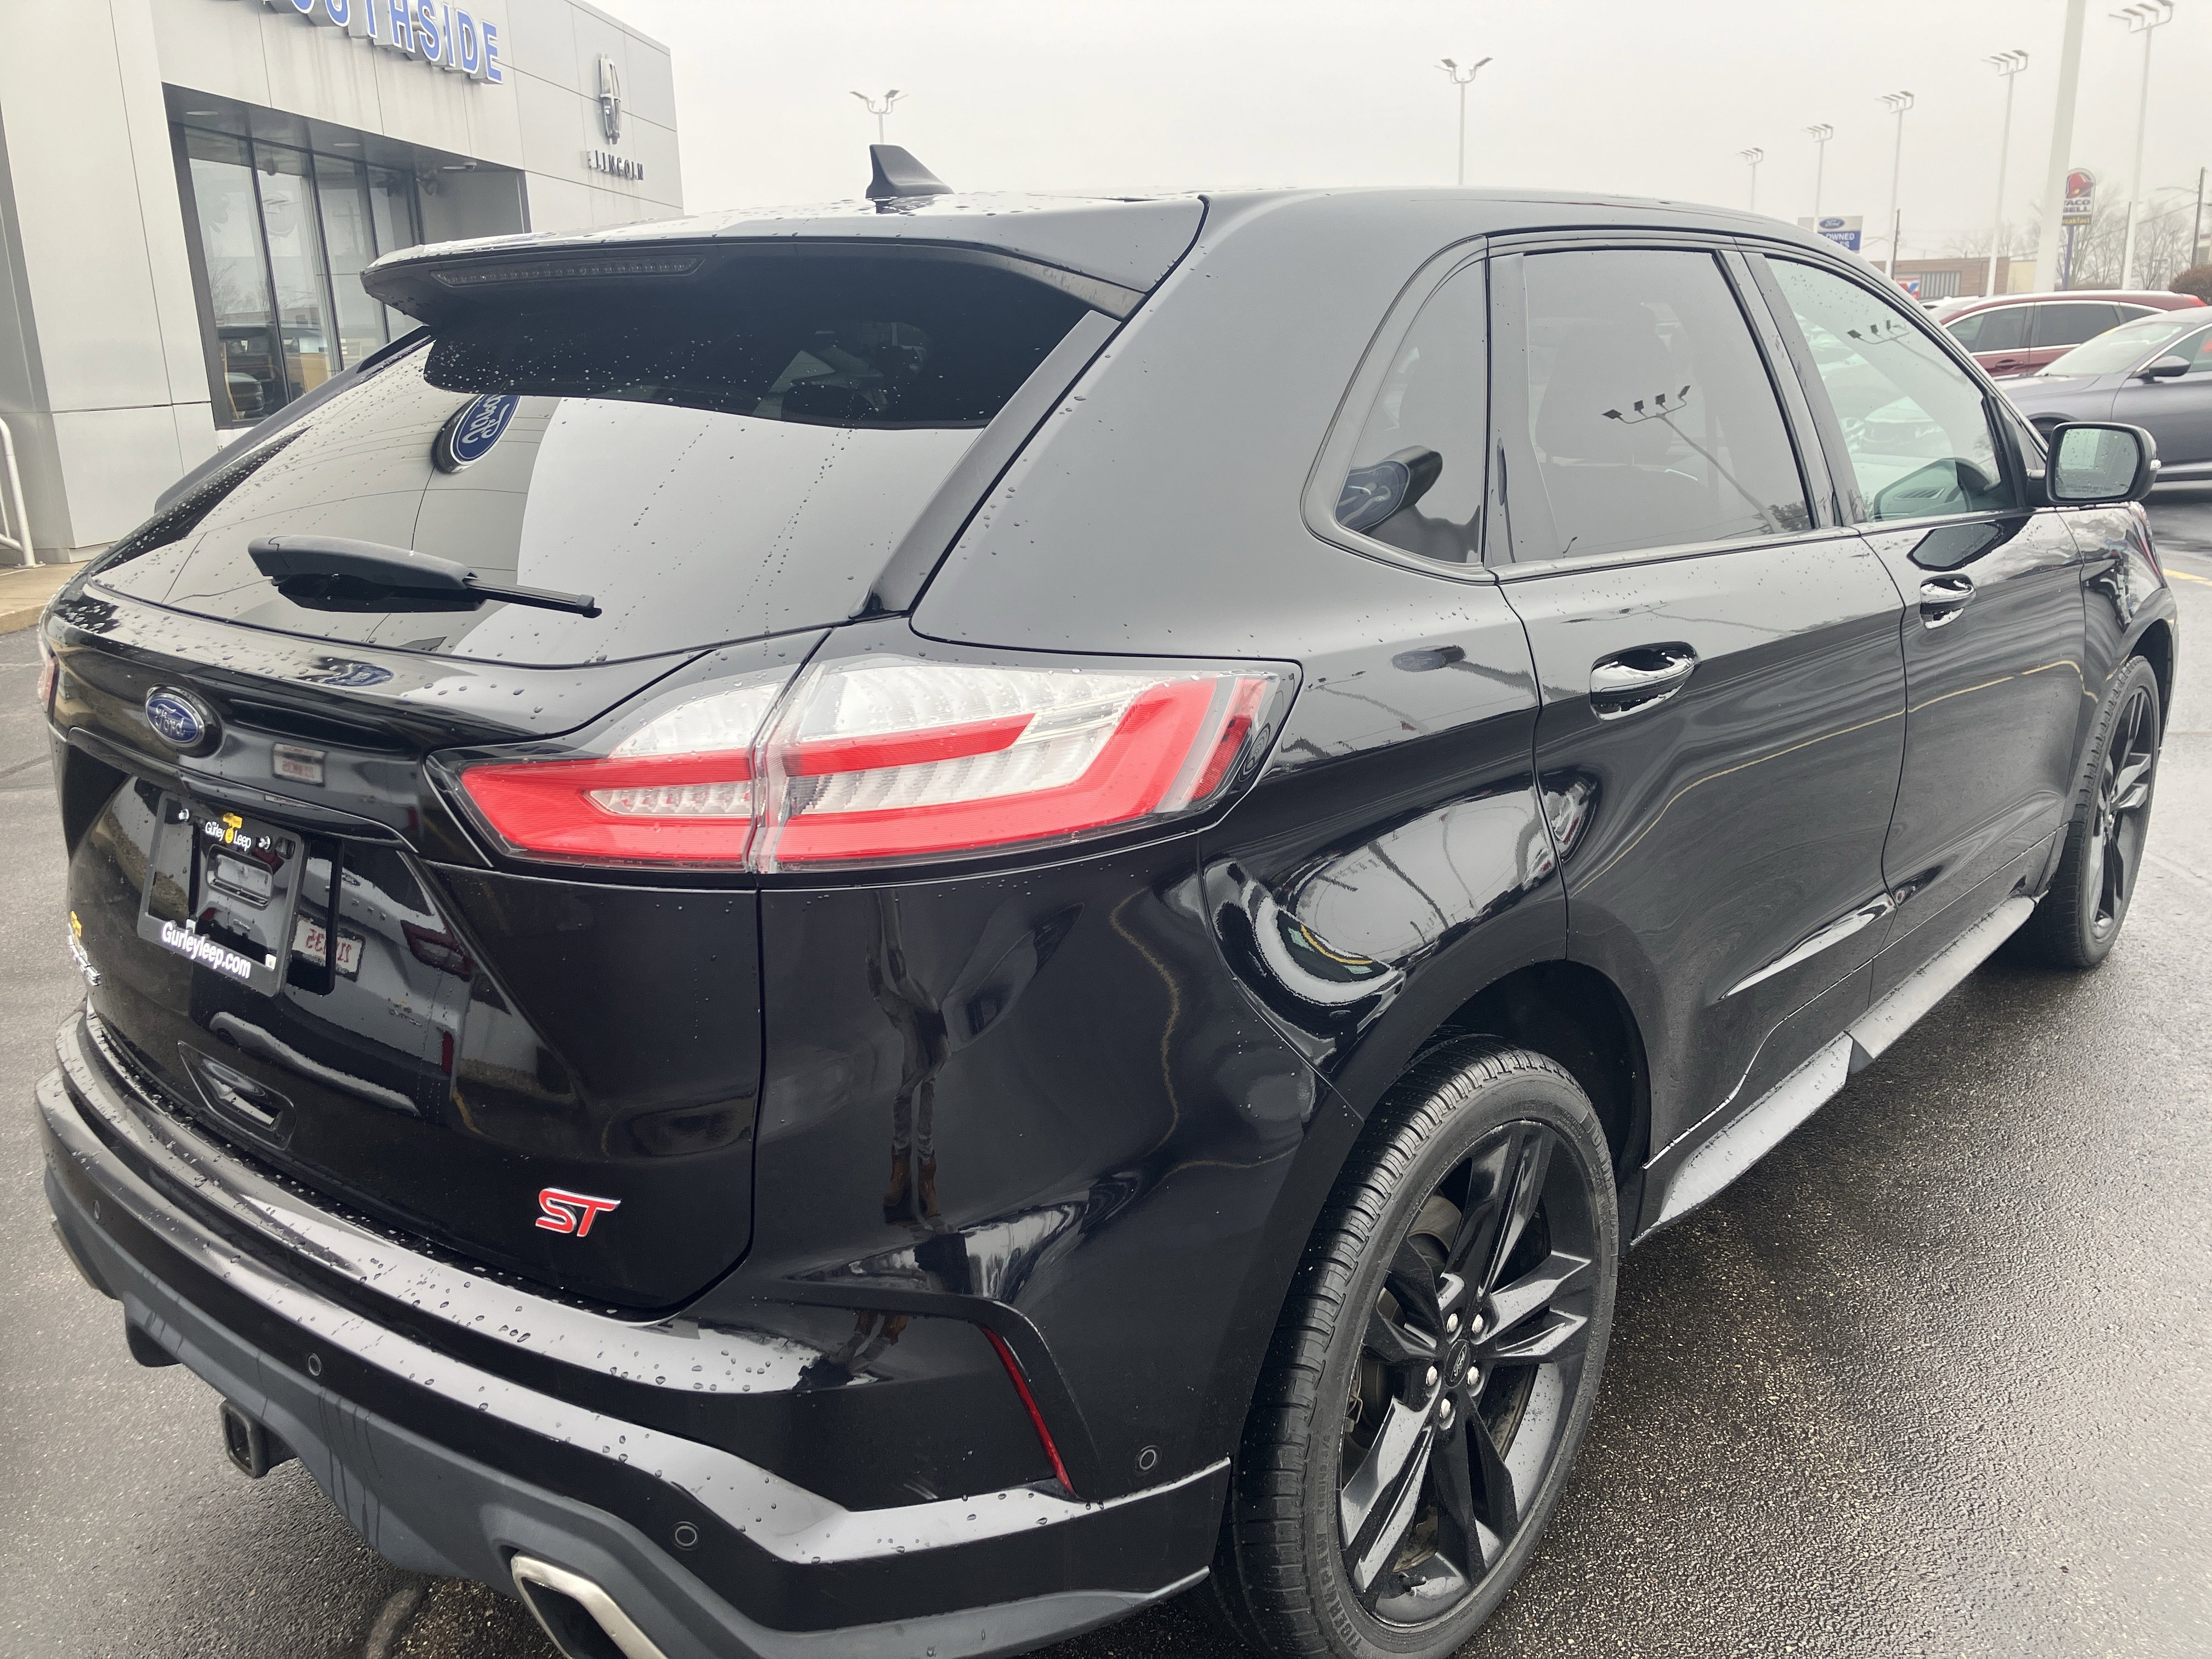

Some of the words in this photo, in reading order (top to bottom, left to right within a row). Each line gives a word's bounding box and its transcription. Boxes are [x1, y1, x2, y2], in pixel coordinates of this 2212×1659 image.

[154, 703, 186, 736] Ford
[205, 821, 225, 842] Gurley
[234, 830, 252, 851] Leep
[535, 1187, 621, 1238] ST
